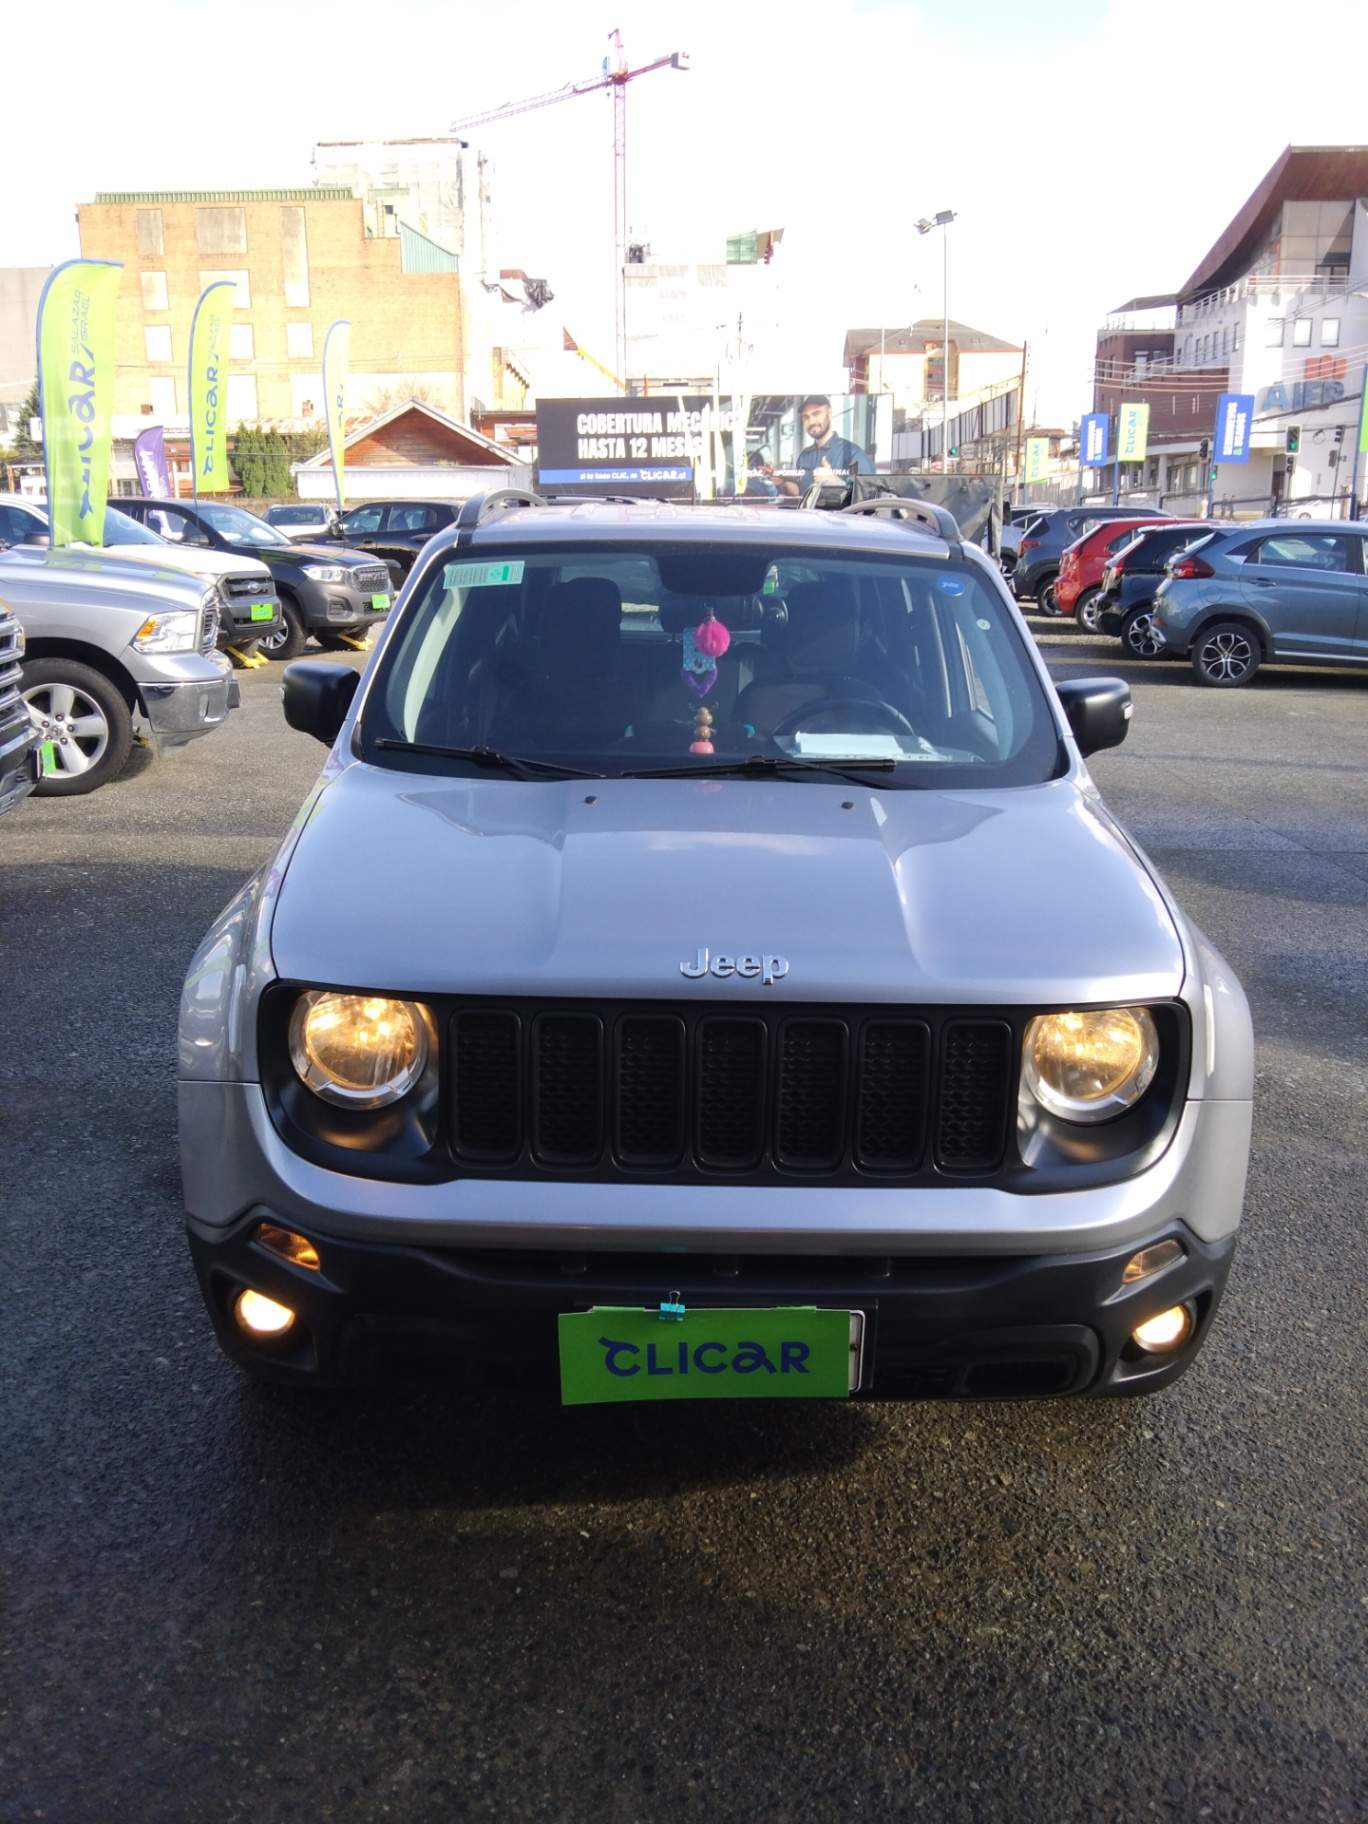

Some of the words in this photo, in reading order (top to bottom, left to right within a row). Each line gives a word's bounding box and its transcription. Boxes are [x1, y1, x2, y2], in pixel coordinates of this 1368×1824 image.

[1259, 380, 1345, 412] AIEP
[577, 412, 662, 434] COBERTURA
[666, 410, 743, 433] MECIC
[578, 437, 625, 459] HASTA
[629, 437, 647, 458] 12
[651, 436, 703, 457] MESS
[679, 947, 790, 985] Jeep
[597, 1337, 811, 1376] CLICAR
